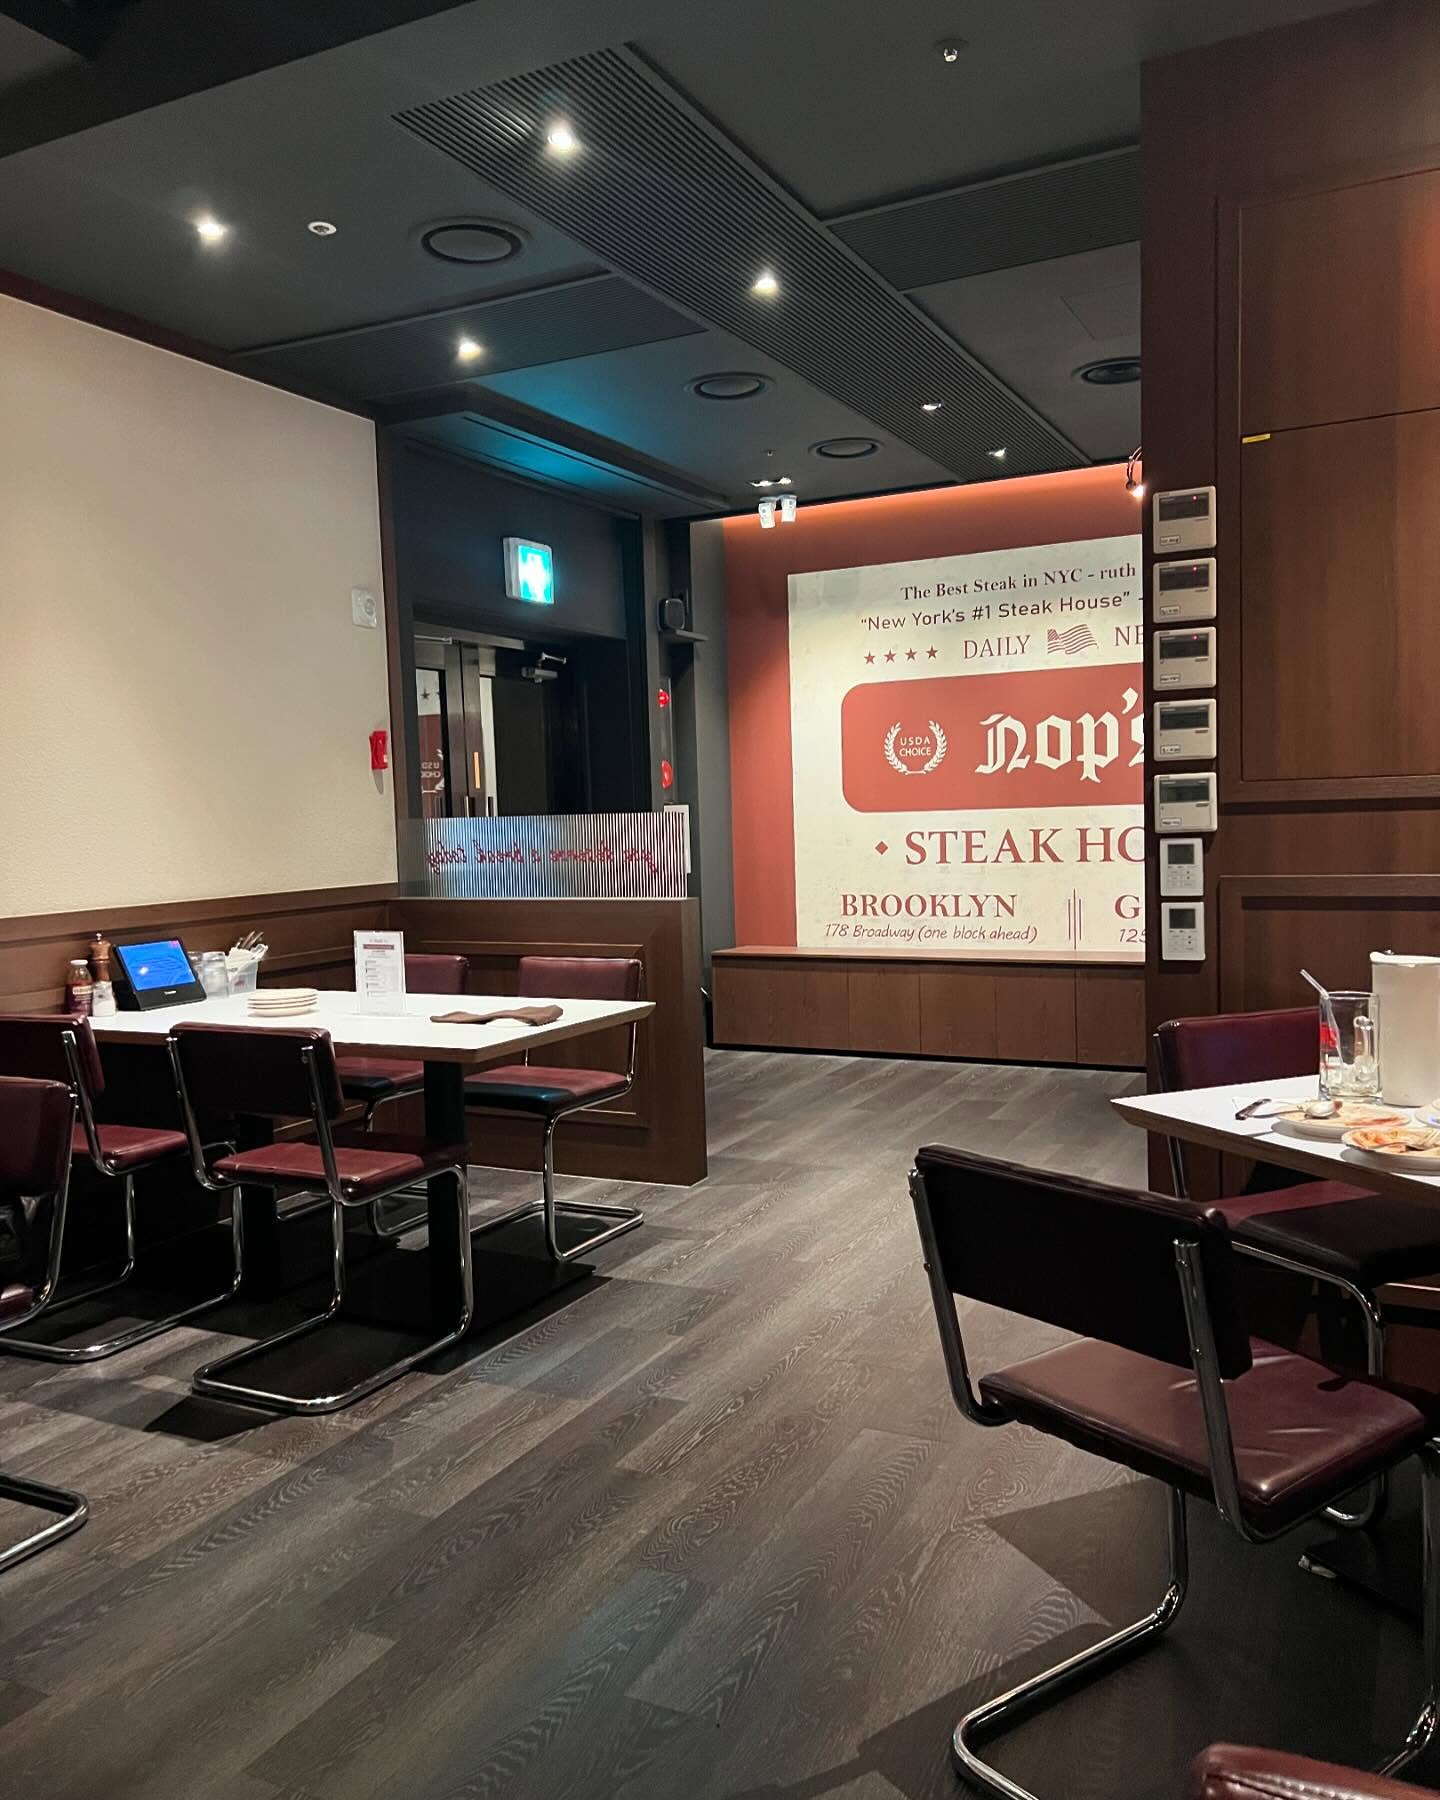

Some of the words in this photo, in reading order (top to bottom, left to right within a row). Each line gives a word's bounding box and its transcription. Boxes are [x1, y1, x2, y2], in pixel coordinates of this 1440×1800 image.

[901, 585, 932, 600] The
[936, 583, 969, 597] Best
[973, 575, 1017, 593] Steak
[1023, 573, 1038, 588] in
[1043, 568, 1083, 586] NYC
[1100, 562, 1136, 580] ruth
[971, 605, 991, 621] #1
[997, 599, 1053, 618] Steak
[963, 634, 1031, 660] DAILY
[899, 746, 932, 757] CHOICE
[900, 735, 931, 746] USDA
[904, 827, 1065, 865] STEAK
[841, 893, 1018, 918] BROOKLYN
[825, 923, 849, 937] 178
[853, 924, 915, 942] Broadway
[918, 925, 948, 942] (one
[953, 926, 986, 940] block
[989, 926, 1038, 943] ahead)
